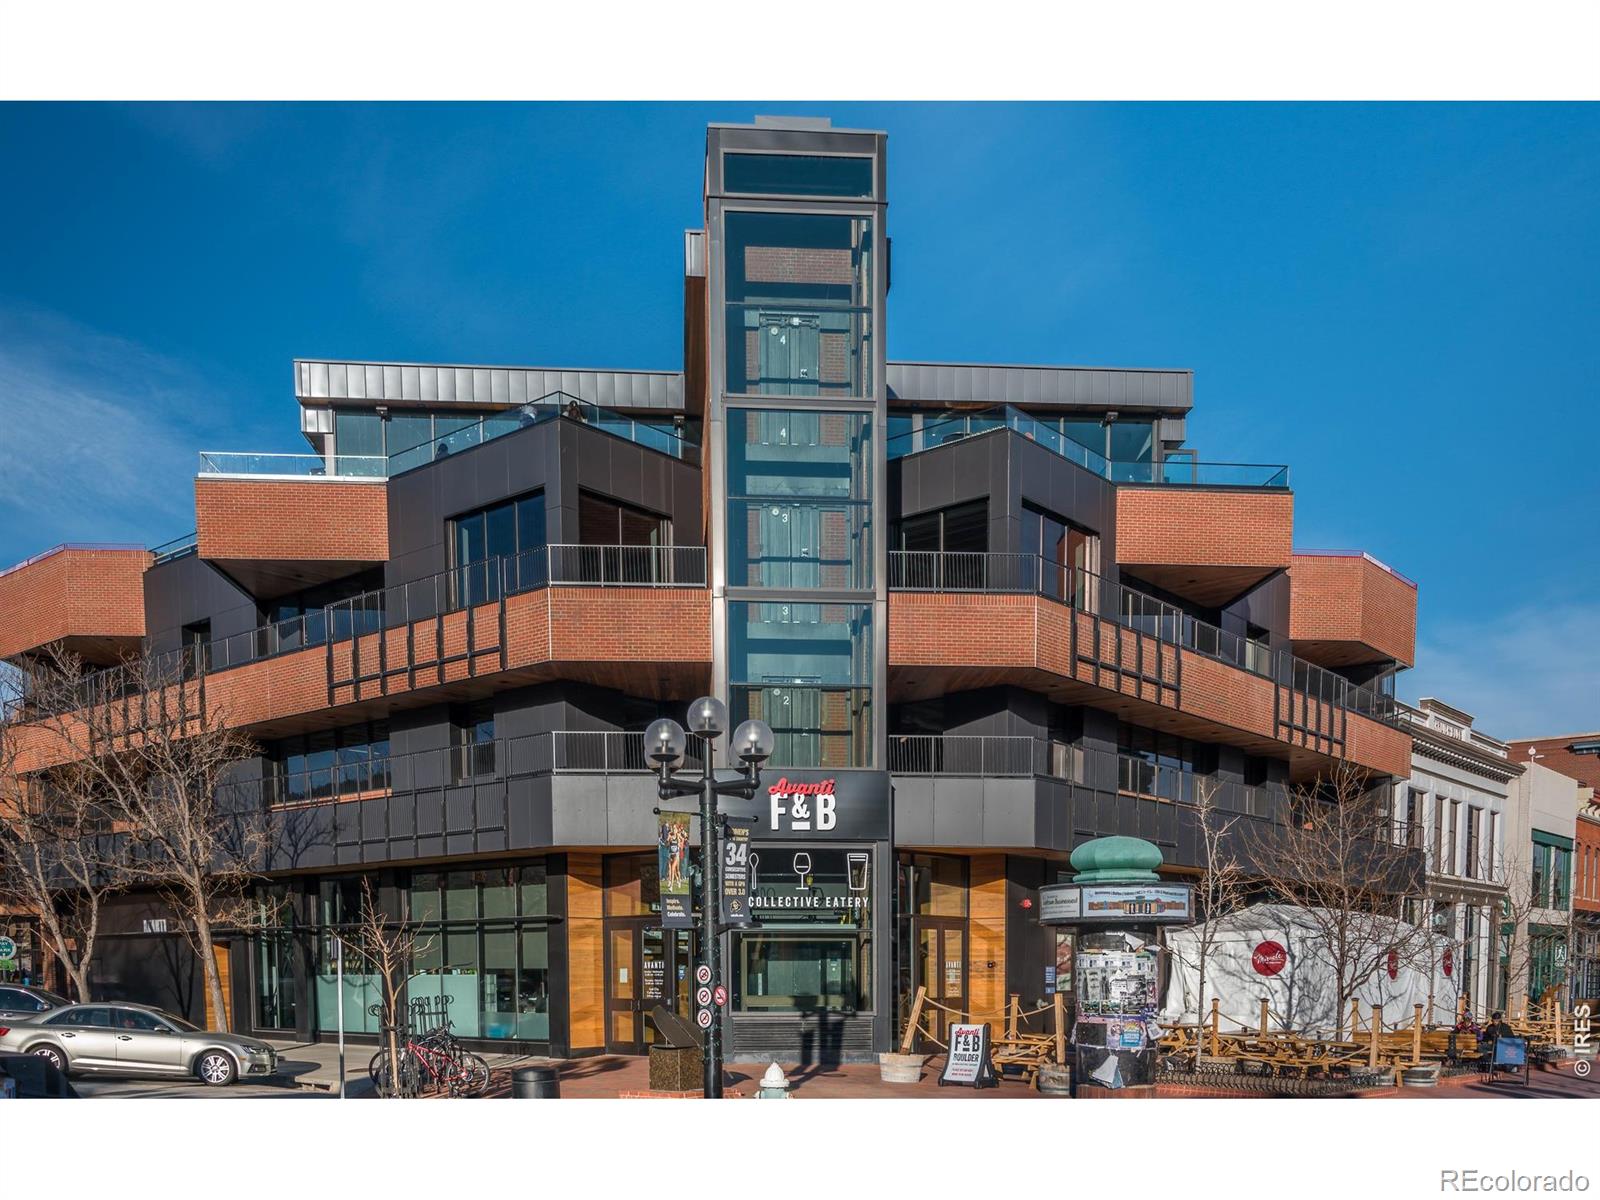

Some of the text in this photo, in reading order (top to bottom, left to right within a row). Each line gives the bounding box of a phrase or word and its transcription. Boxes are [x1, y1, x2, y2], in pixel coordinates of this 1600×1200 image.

[780, 428, 786, 438] 4
[782, 513, 788, 523] 3
[782, 606, 789, 616] 3
[783, 695, 790, 705] 2
[768, 777, 835, 797] Avanti
[725, 842, 747, 866] 34
[725, 887, 746, 896] OVER 3.0
[748, 896, 869, 908] COLLECTIVE EATERY
[644, 961, 665, 969] AVANTI
[955, 1027, 980, 1037] Avanti
[953, 1053, 980, 1062] BOULDER
